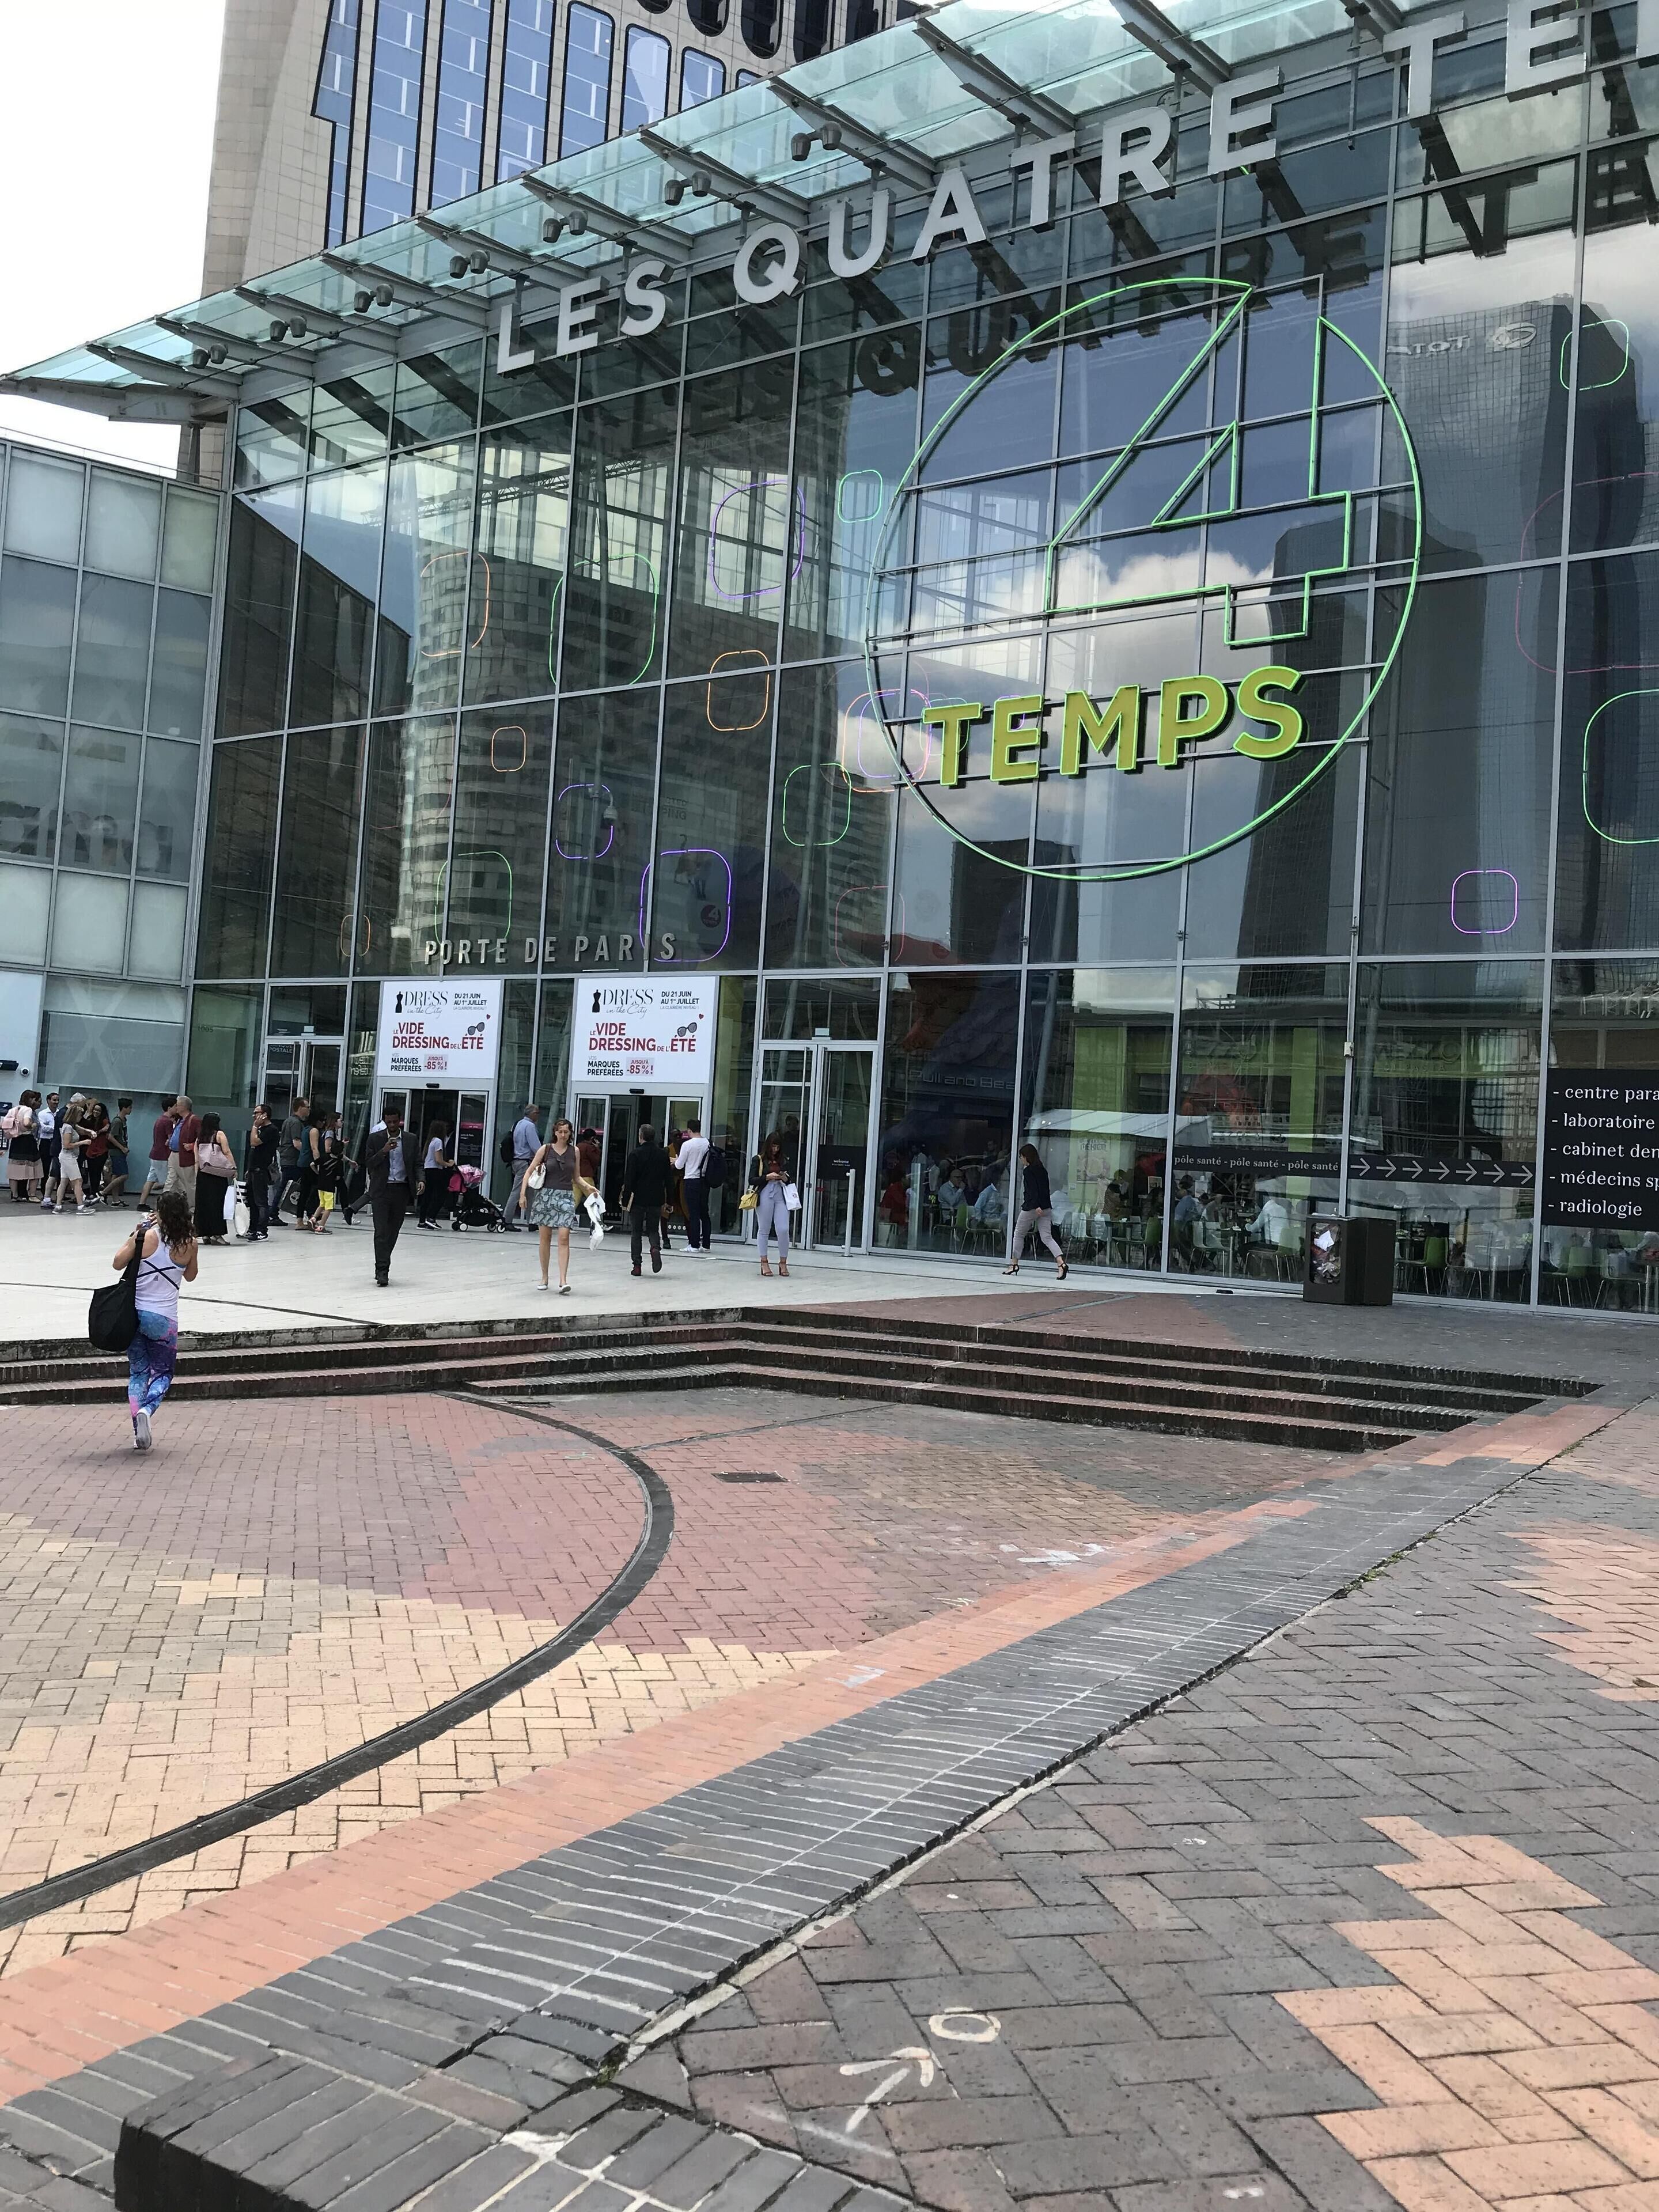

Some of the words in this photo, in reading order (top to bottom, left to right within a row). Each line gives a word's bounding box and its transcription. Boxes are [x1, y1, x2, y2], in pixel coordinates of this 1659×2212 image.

[497, 260, 674, 374] LES
[733, 66, 1283, 304] QUATRE
[1382, 0, 1659, 118] TE
[1044, 283, 1351, 645] 4
[922, 665, 1305, 787] TEMPS
[424, 938, 508, 965] PORTE
[524, 936, 558, 963] DE
[574, 933, 676, 963] PARIS
[404, 991, 448, 1006] DRESS
[603, 989, 654, 1005] DRESS
[425, 1006, 442, 1019] City
[616, 1005, 626, 1013] the
[627, 1004, 647, 1019] City
[398, 1022, 425, 1035] VIDE
[596, 1022, 626, 1036] VIDE
[392, 1036, 449, 1049] DRESSING
[589, 1038, 656, 1051] DRESSING
[1565, 1086, 1619, 1100] centre
[1624, 1088, 1659, 1103] para
[1563, 1112, 1655, 1130] laboratoire
[1562, 1142, 1624, 1157] cabinet
[1630, 1143, 1659, 1158] den
[1175, 1154, 1194, 1165] pôle
[1230, 1157, 1251, 1168] pôle
[1253, 1160, 1279, 1168] santé
[1288, 1160, 1309, 1171] pôle
[1312, 1162, 1338, 1171] santé
[1560, 1171, 1641, 1187] médecins
[1560, 1199, 1642, 1219] radiologie
